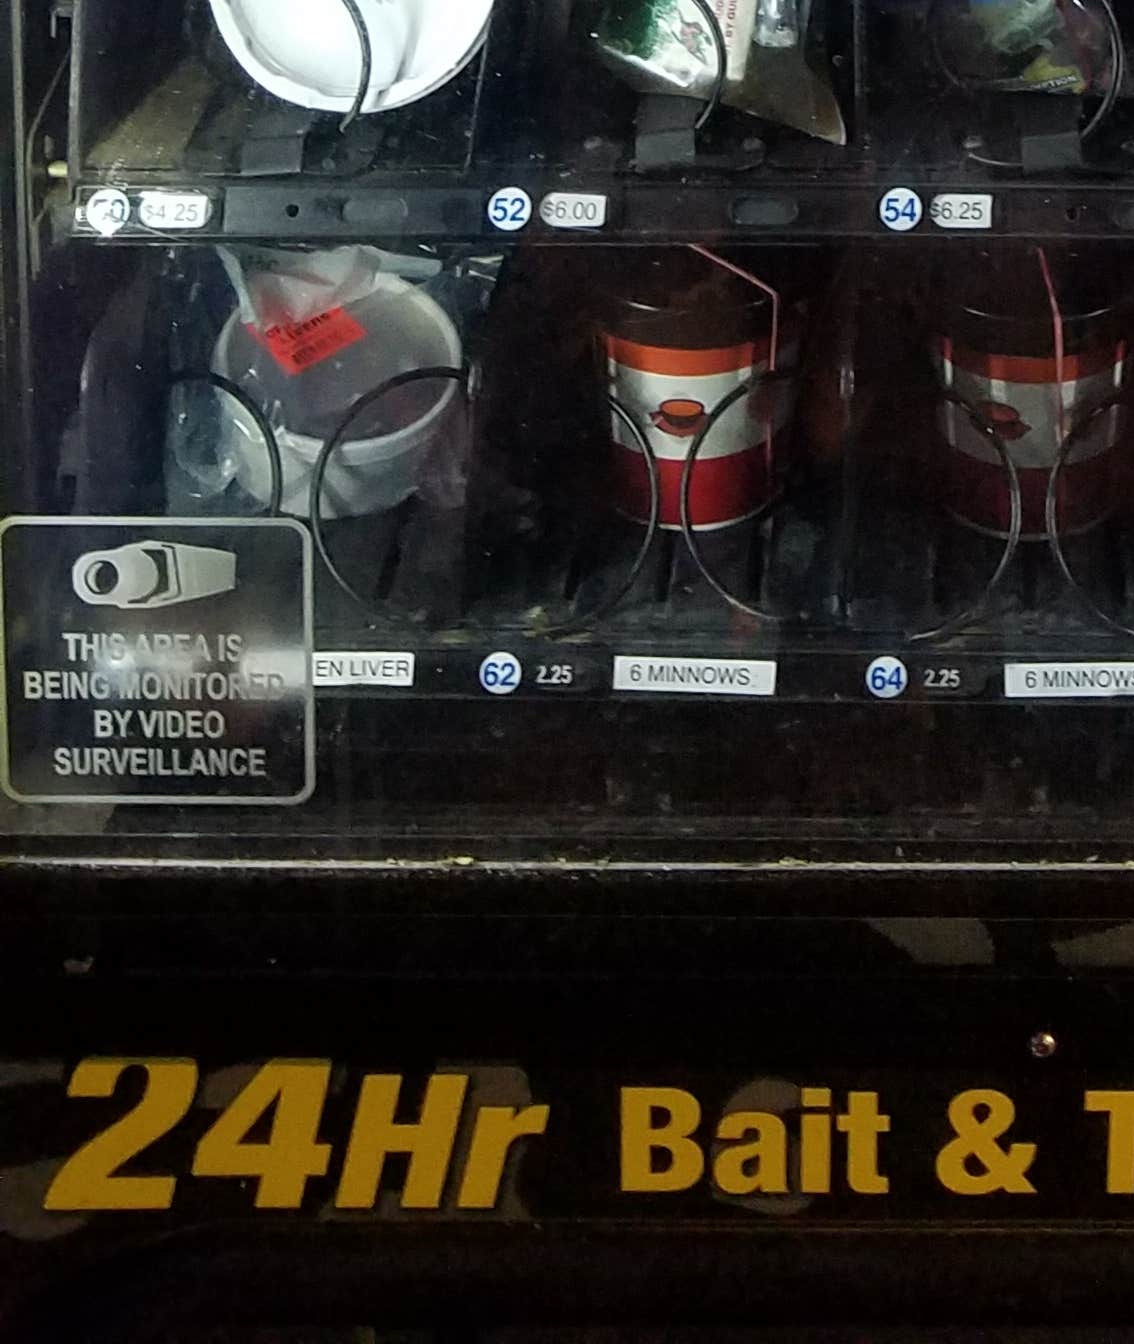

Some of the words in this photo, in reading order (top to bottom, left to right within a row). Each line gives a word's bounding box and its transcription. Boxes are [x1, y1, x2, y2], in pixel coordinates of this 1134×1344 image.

[144, 204, 197, 223] $4.25
[493, 197, 525, 221] 52
[543, 201, 597, 219] $6.00
[885, 198, 917, 221] 54
[930, 201, 984, 221] $6.25
[62, 633, 126, 662] THIS
[133, 634, 209, 662] AREA
[217, 634, 243, 660] IS
[348, 659, 410, 681] LIVER
[483, 661, 517, 687] 62
[536, 665, 572, 684] 2.25
[629, 664, 642, 684] 6
[646, 664, 751, 687] MINNOWS
[870, 665, 903, 690] 64
[924, 669, 960, 688] 2.25
[1025, 669, 1037, 689] 6
[24, 670, 109, 700] BEING
[119, 670, 288, 700] MONITORED
[94, 710, 133, 738] BY
[139, 710, 226, 738] VIDEO
[53, 747, 268, 777] SURVEILLANCE
[43, 1056, 548, 1210] 24Hr
[620, 1085, 891, 1197] Bait
[935, 1088, 1038, 1196] &
